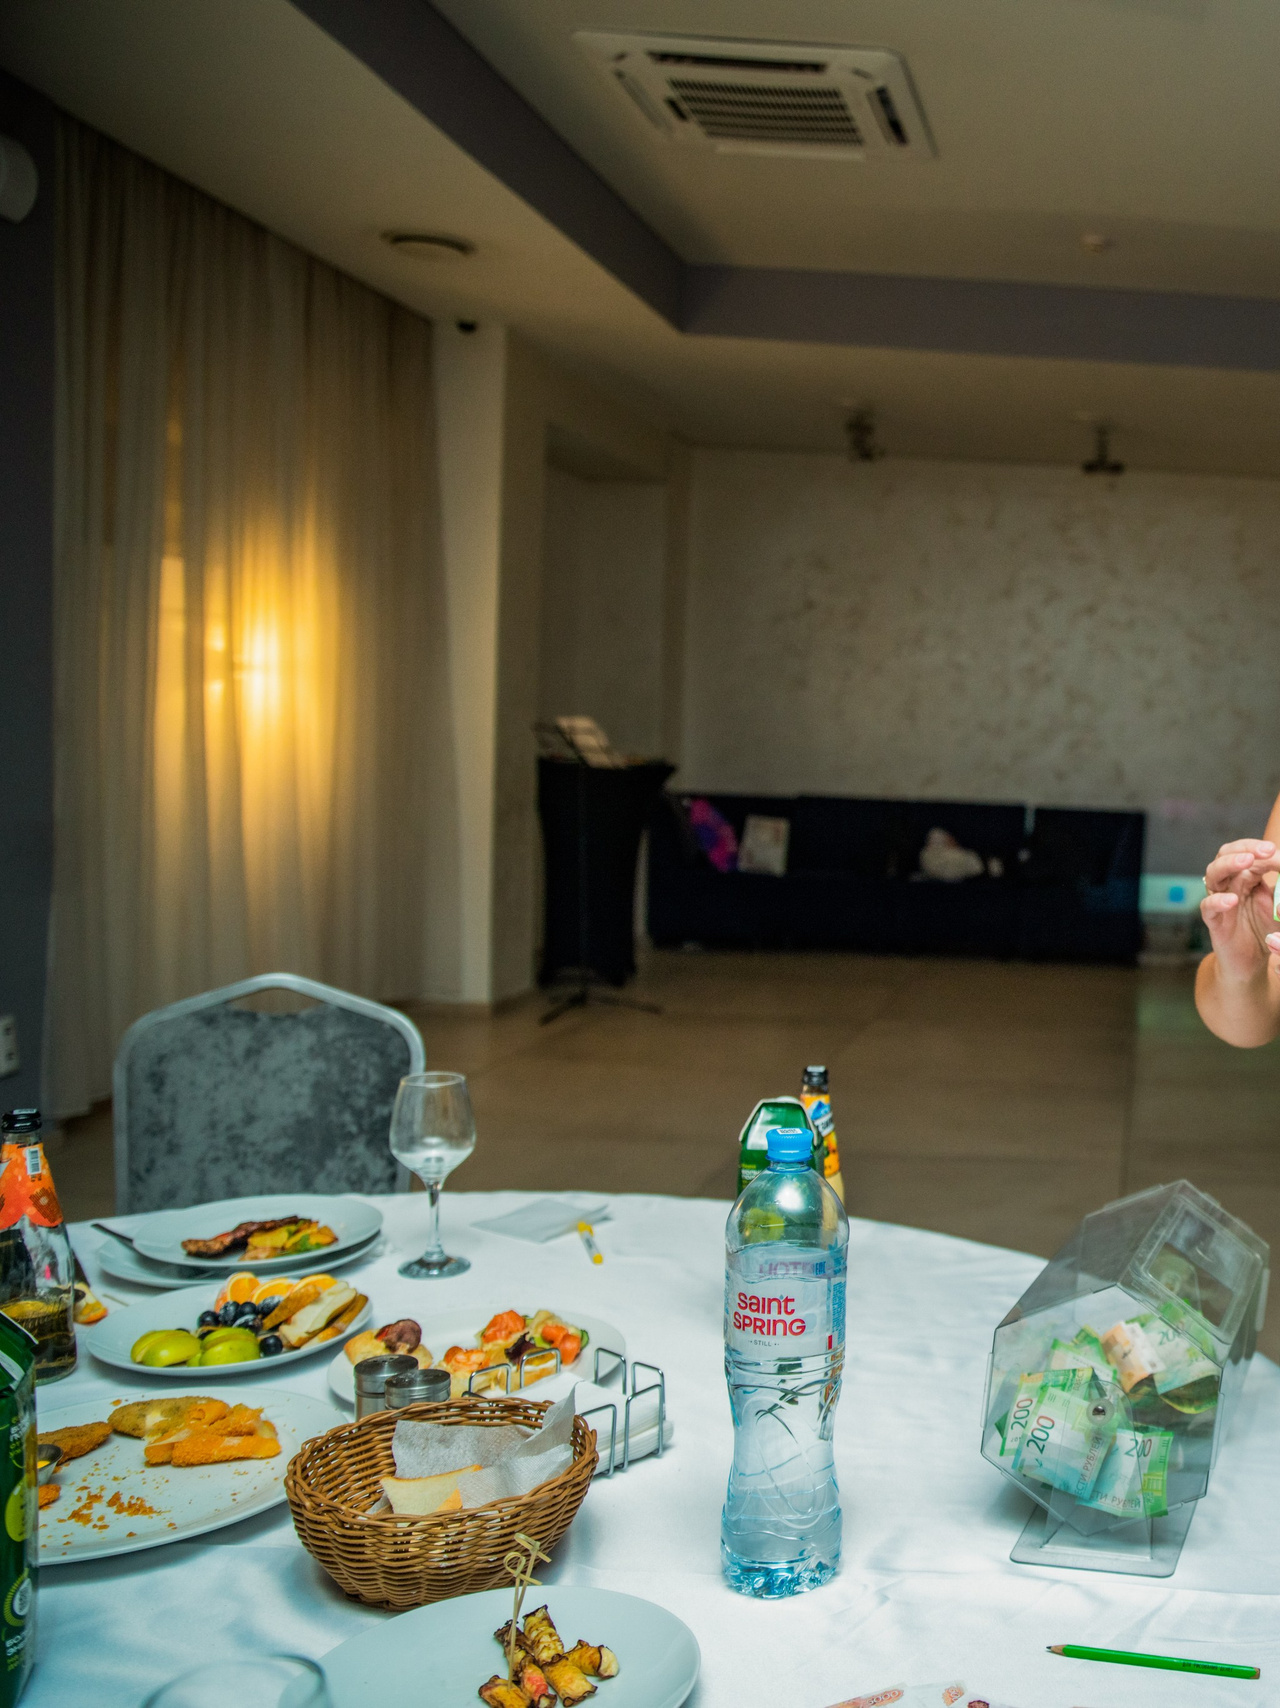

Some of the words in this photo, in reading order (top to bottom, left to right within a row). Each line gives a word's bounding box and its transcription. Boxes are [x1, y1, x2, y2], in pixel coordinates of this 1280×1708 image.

[1010, 1398, 1034, 1431] 200
[1026, 1415, 1055, 1455] 200
[1074, 1472, 1088, 1496] ЕСТИ
[1083, 1434, 1103, 1471] РУБЛЕЙ
